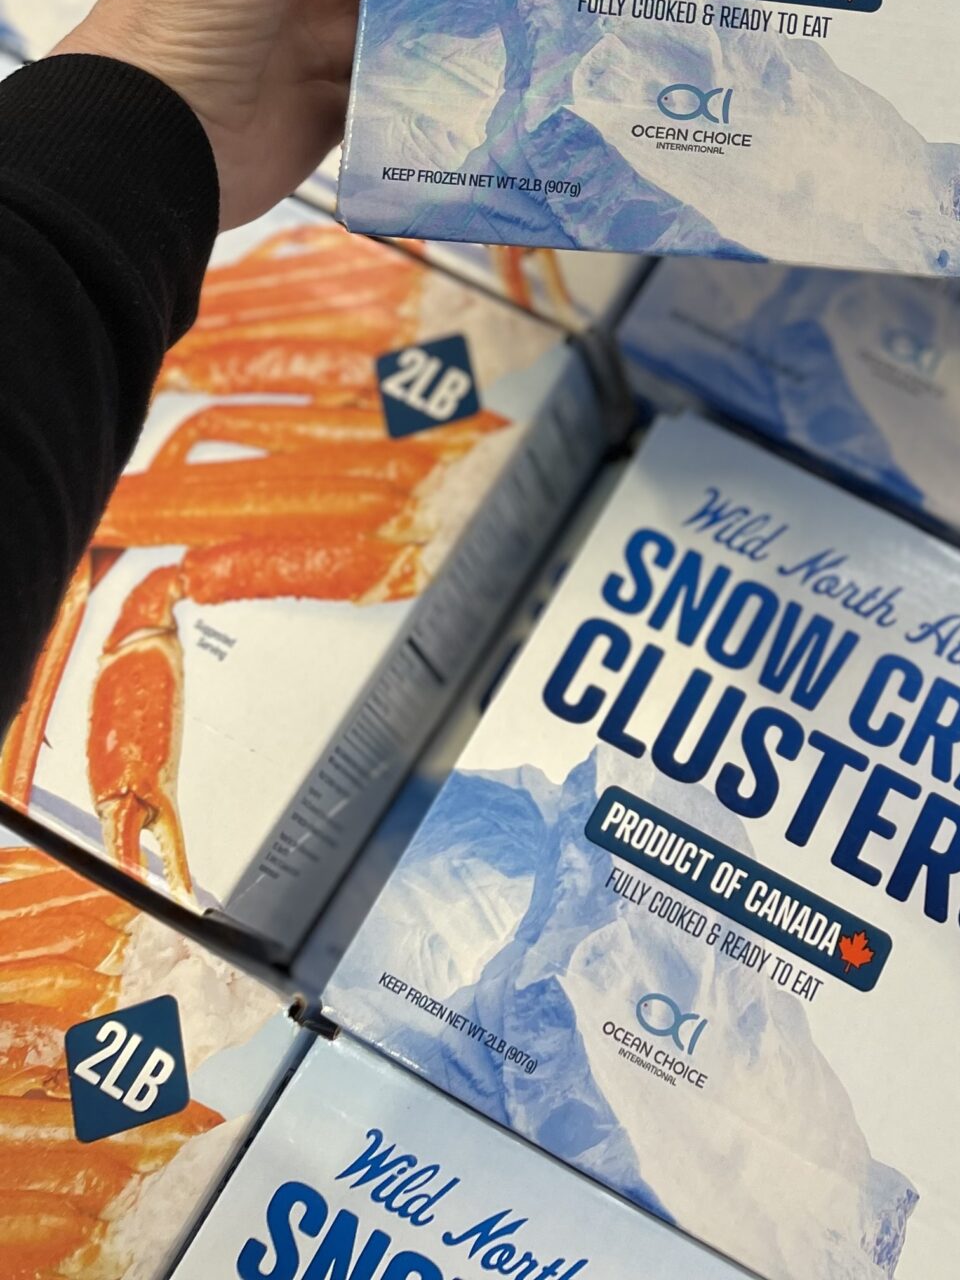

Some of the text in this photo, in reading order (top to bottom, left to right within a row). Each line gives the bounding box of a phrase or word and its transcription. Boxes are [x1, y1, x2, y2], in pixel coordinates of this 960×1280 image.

[703, 3, 715, 26] &
[719, 4, 771, 32] READY
[777, 11, 799, 35] TO
[803, 15, 832, 39] EAT
[631, 124, 753, 148] OCEAN CHOICE
[656, 141, 725, 155] INTERNATIONAL
[382, 167, 581, 197] KEEP FROZEN NET WT 2LB (907g)
[381, 348, 474, 421] 2LB
[682, 488, 790, 563] Wild
[778, 548, 902, 628] North
[601, 528, 860, 712] SNOW
[601, 800, 843, 958] PRODUCT OF CANADA
[604, 867, 824, 1003] FULLY COOKED & READY TO EAT
[379, 971, 538, 1075] KEEP FROZEN NET WT 2LB (907g)
[602, 1021, 708, 1090] OCEAN CHOICE
[74, 1020, 176, 1113] 2LB
[618, 1048, 678, 1088] INTERNATIONAL
[335, 1128, 460, 1226] Wild
